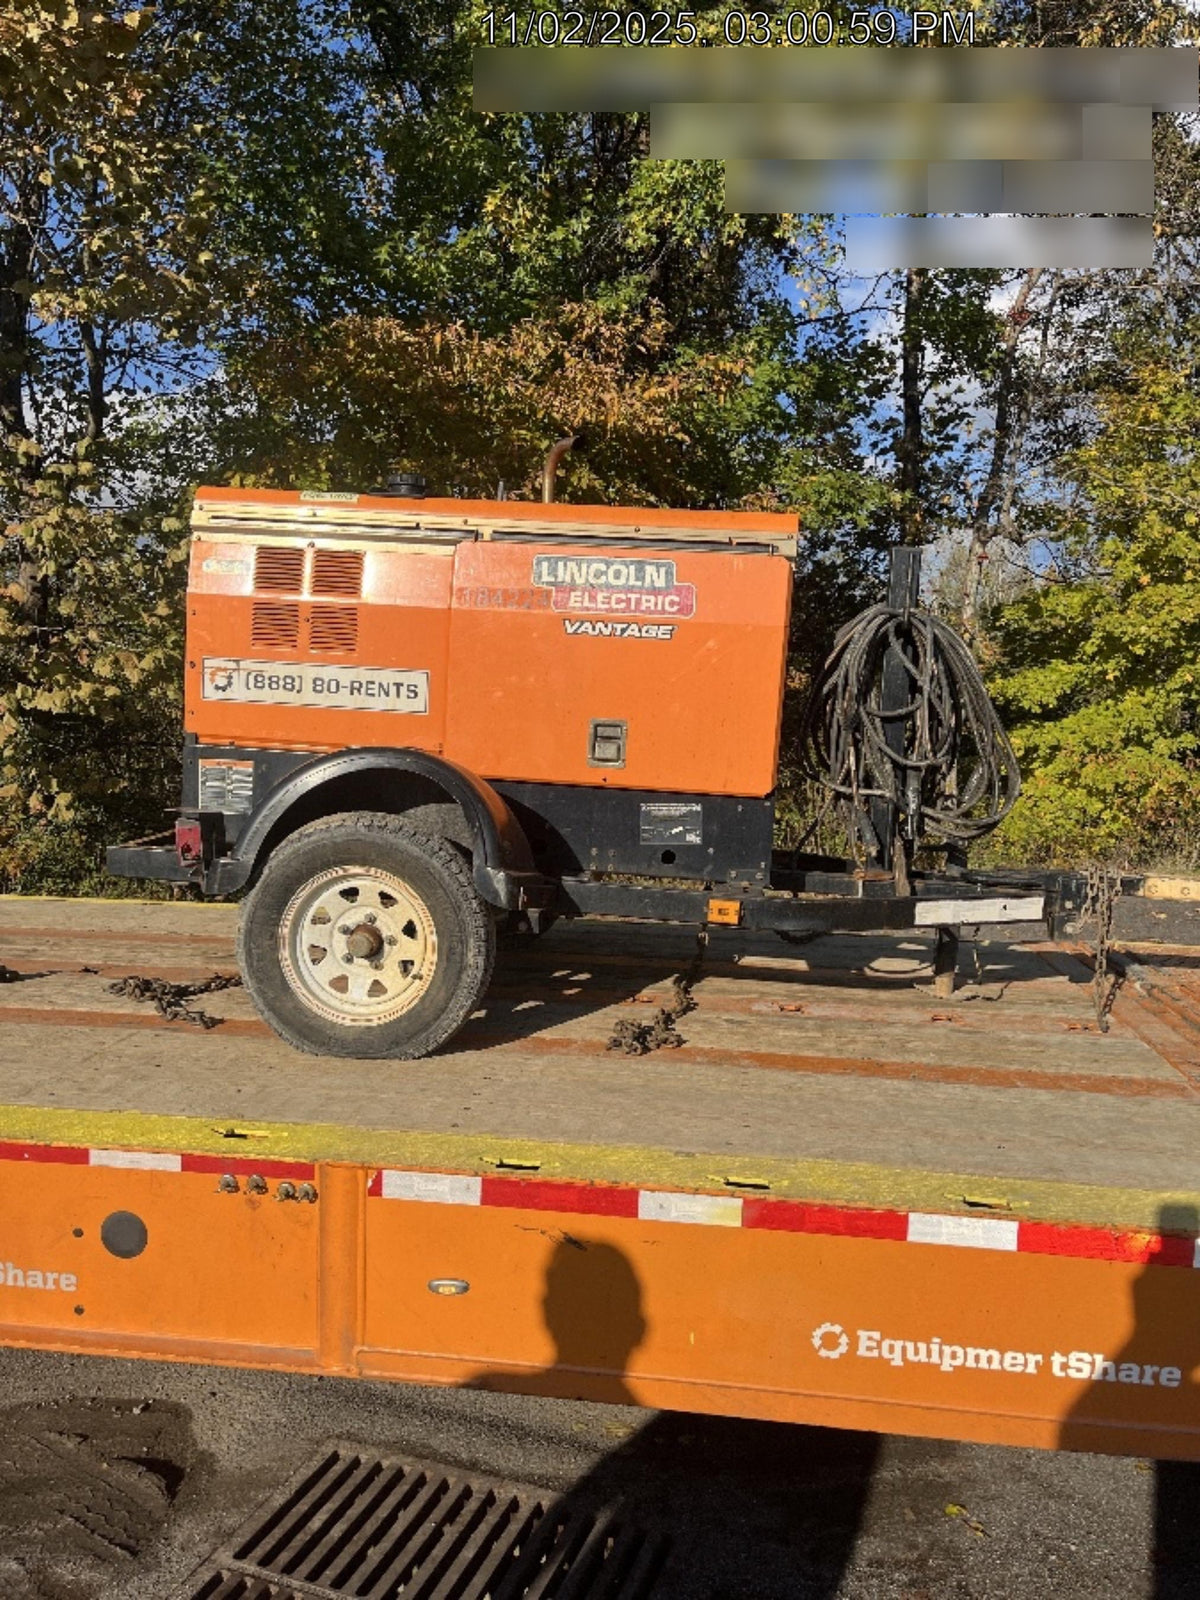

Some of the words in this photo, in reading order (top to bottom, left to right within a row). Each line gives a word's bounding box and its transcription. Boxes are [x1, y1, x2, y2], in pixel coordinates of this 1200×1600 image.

[541, 561, 666, 588] LINCOLN
[568, 591, 681, 612] ELECTRIC
[563, 619, 674, 640] VANTAGE
[246, 671, 303, 694] (888)
[312, 677, 419, 700] 80-RENTS
